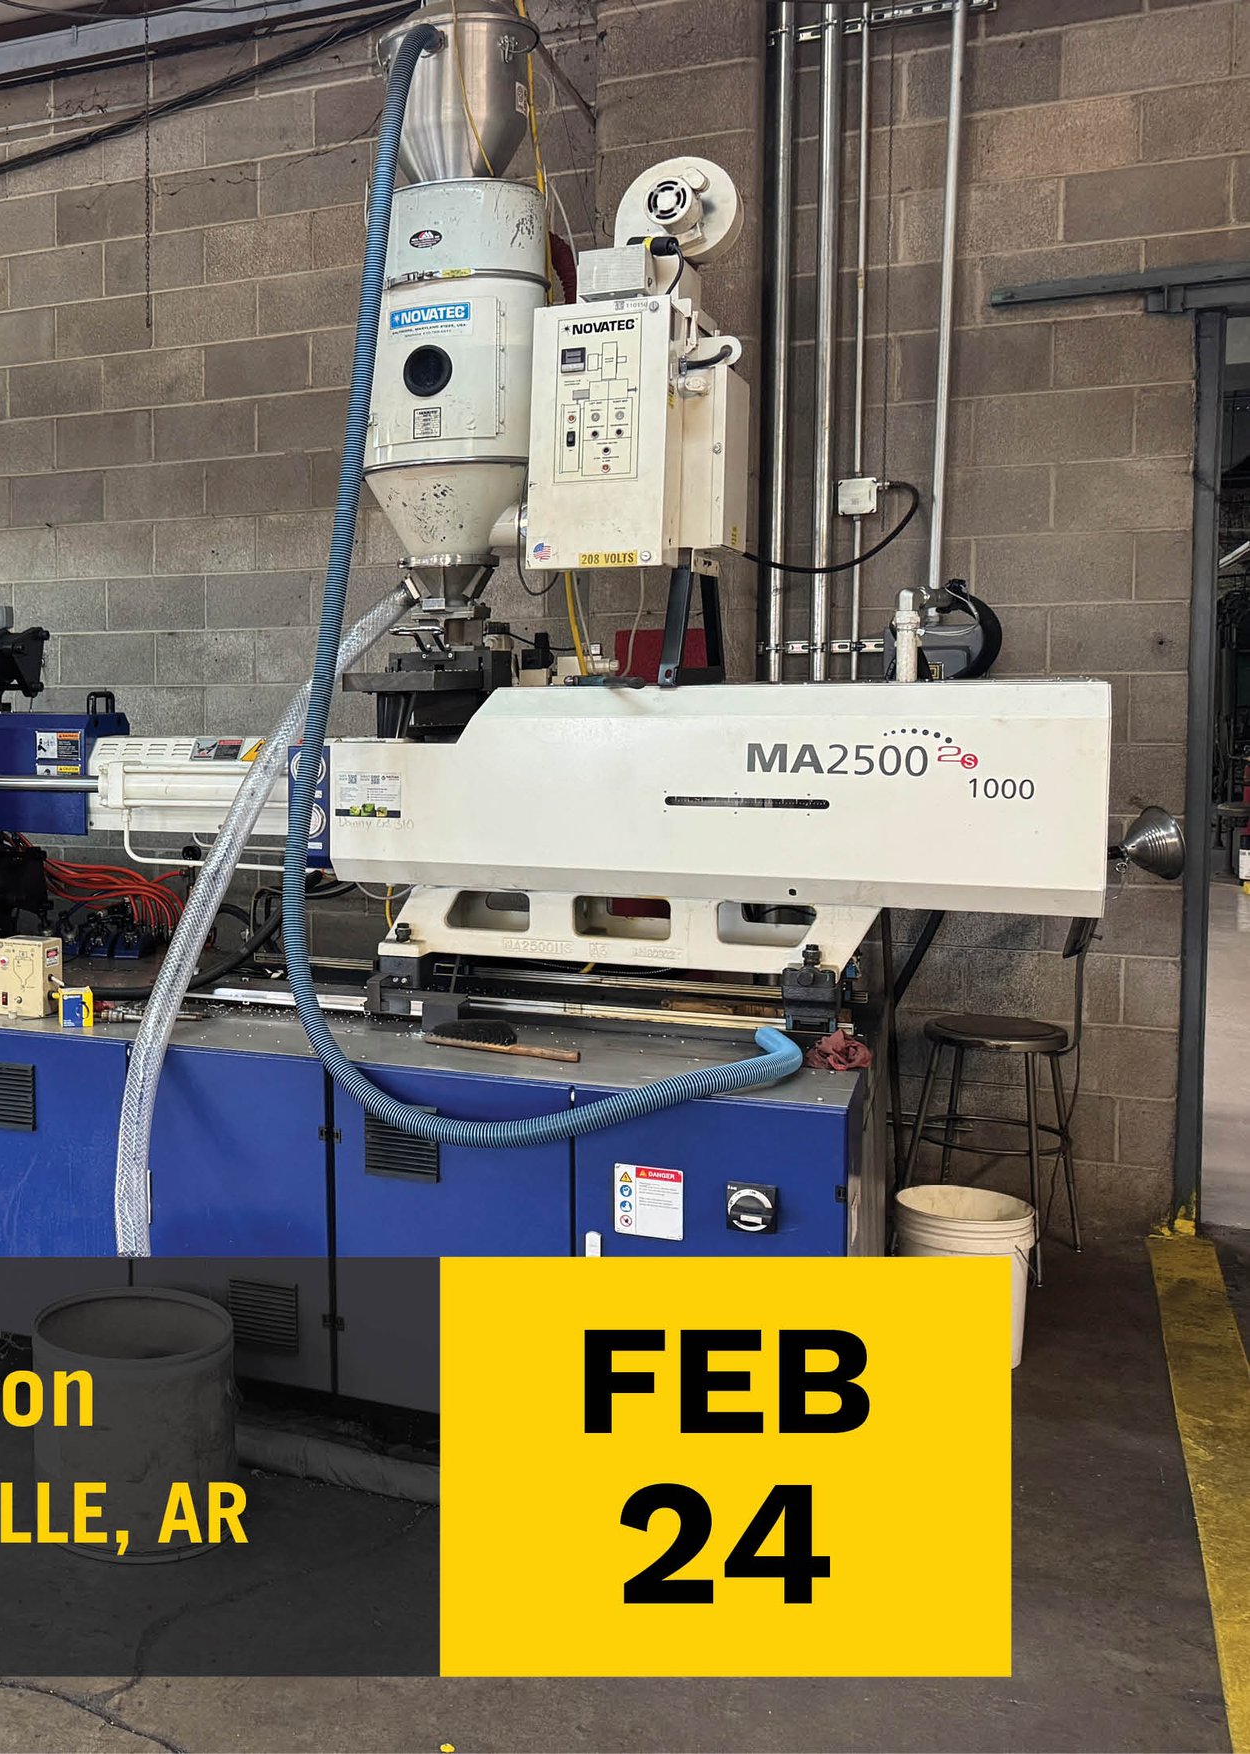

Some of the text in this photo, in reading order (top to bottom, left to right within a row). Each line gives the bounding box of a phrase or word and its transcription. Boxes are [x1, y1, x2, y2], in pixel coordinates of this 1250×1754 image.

[400, 305, 466, 324] NOVATEC
[572, 318, 635, 336] NOVATEC
[581, 552, 634, 565] 208 VOLTS
[746, 742, 929, 777] MA2500
[968, 778, 1035, 800] 1000
[648, 1171, 675, 1180] DANGER
